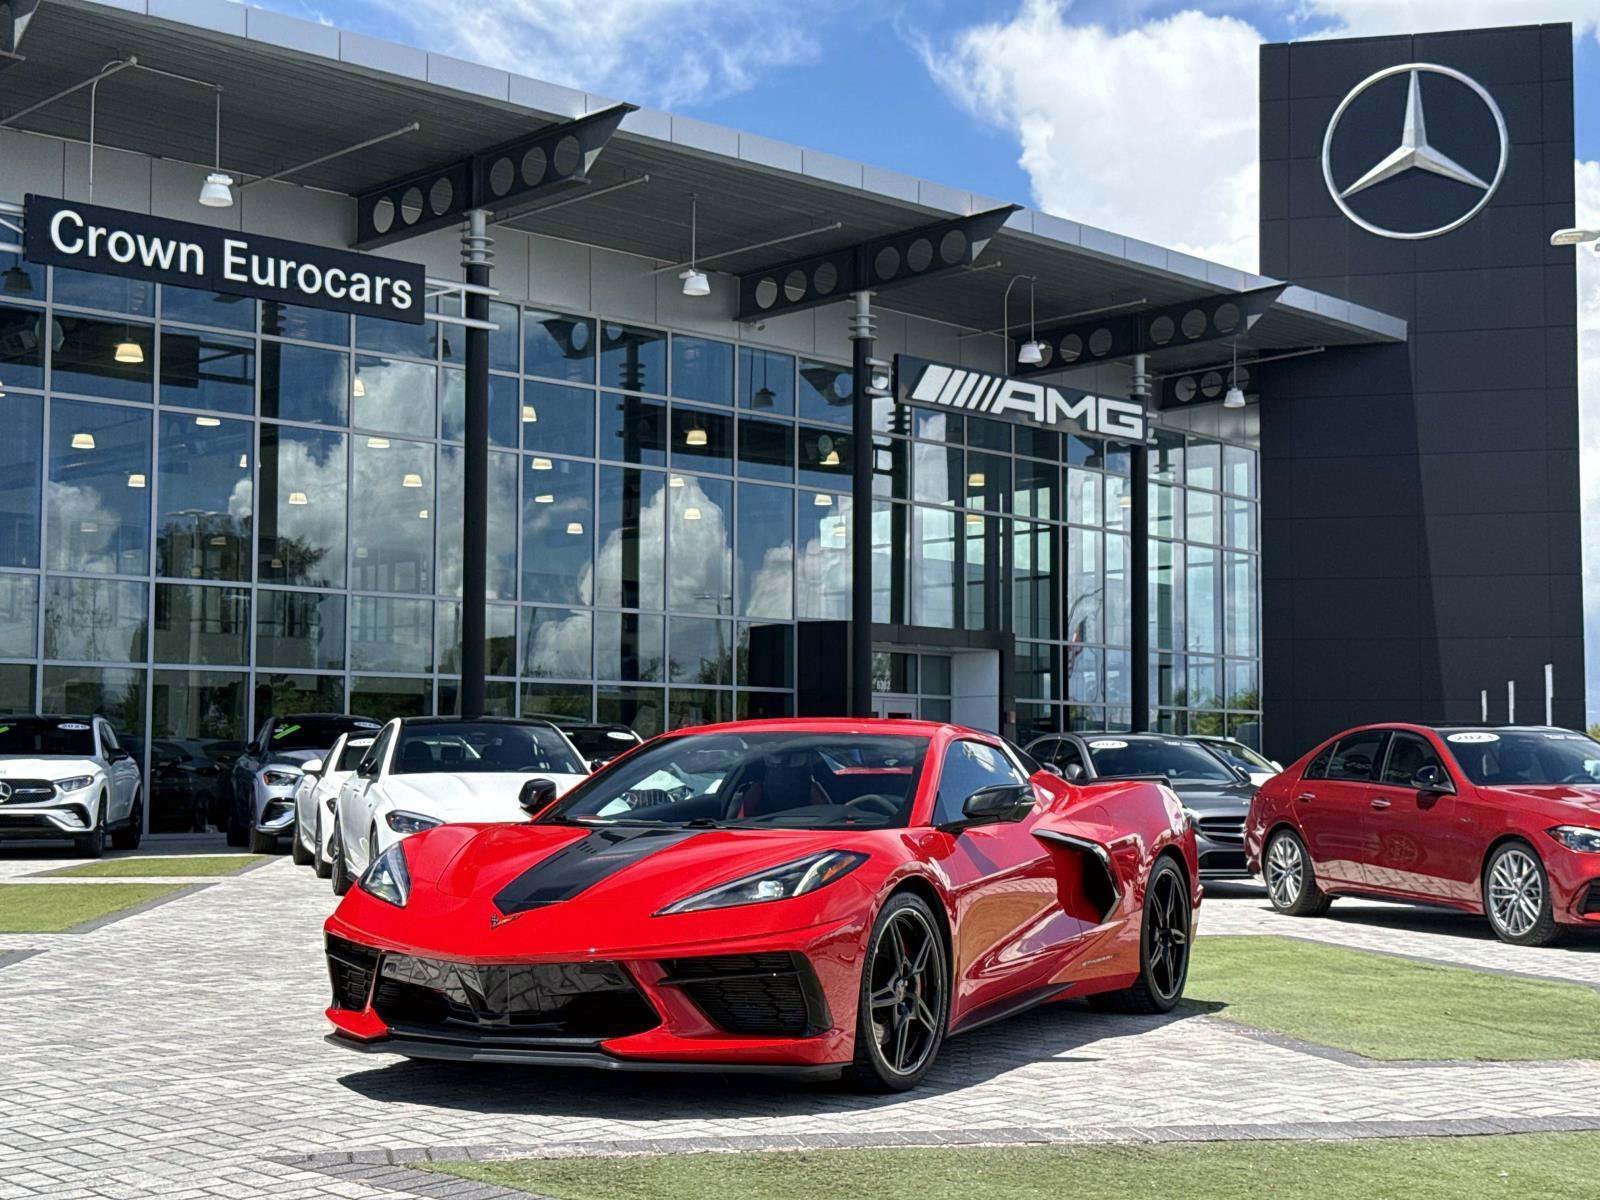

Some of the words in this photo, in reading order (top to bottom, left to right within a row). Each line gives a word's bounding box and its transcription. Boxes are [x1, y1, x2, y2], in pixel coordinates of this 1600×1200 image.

[49, 209, 205, 276] Crown
[223, 238, 413, 310] Eurocars
[990, 378, 1143, 440] AMG
